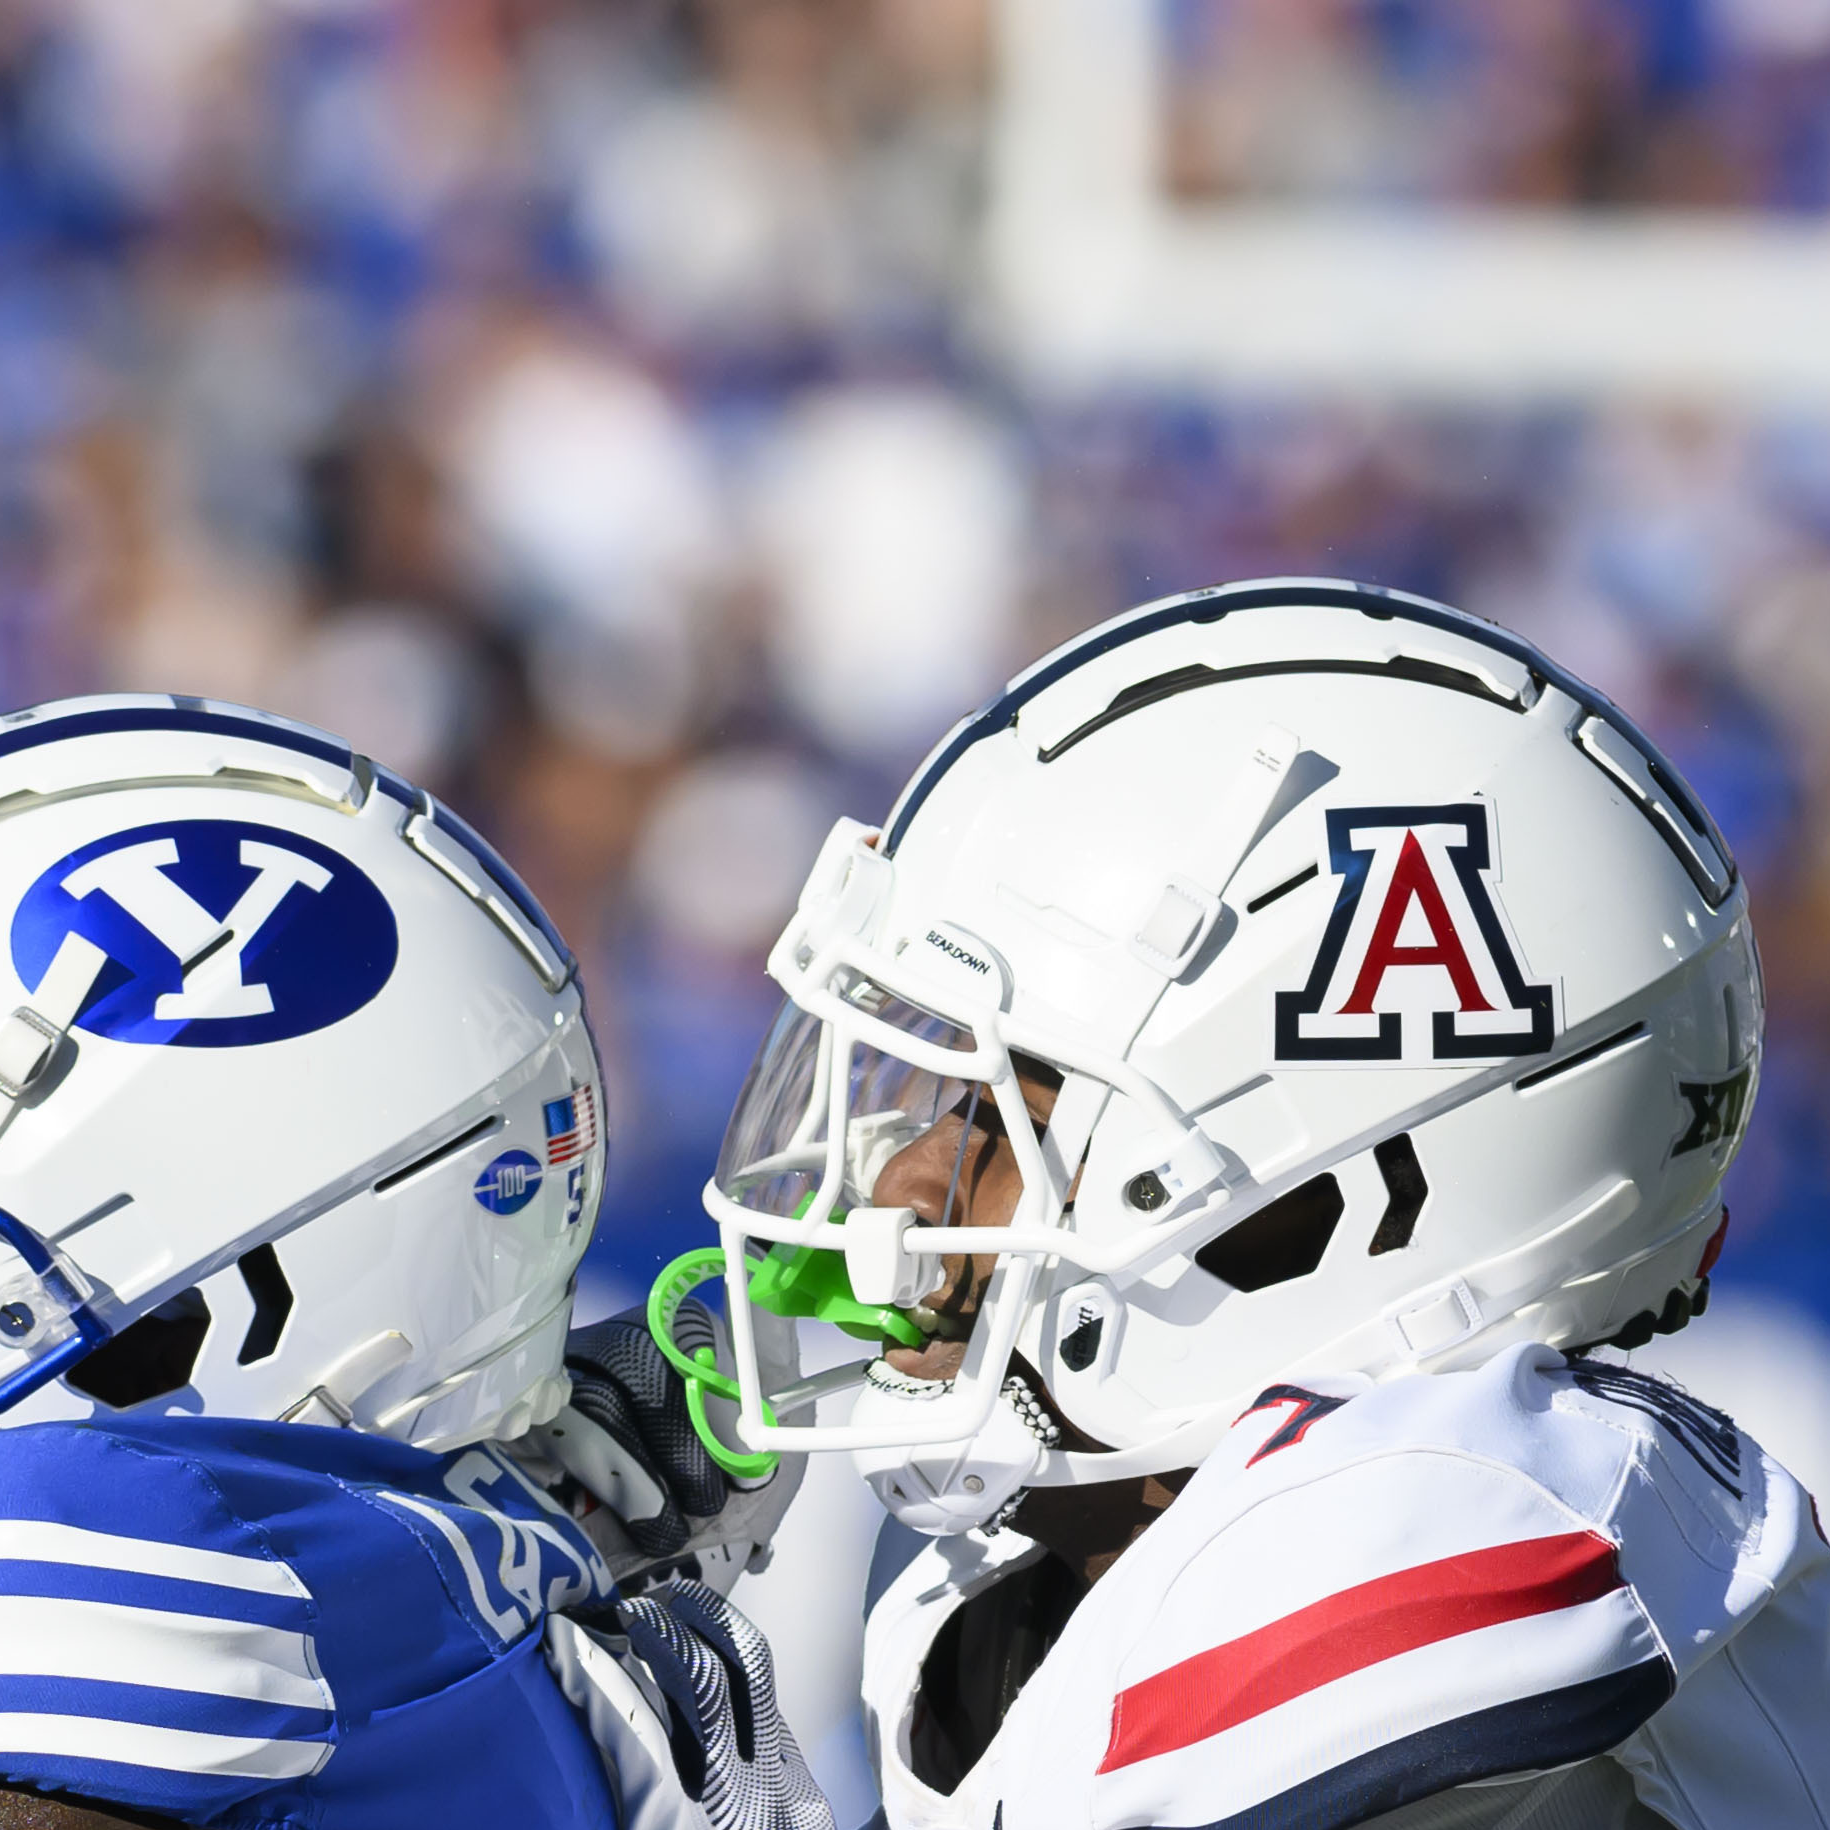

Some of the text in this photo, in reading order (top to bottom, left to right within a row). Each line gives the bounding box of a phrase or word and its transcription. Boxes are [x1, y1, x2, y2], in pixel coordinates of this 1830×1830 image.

[60, 836, 333, 1019] Y
[1274, 803, 1555, 1061] A
[496, 1165, 526, 1199] 100
